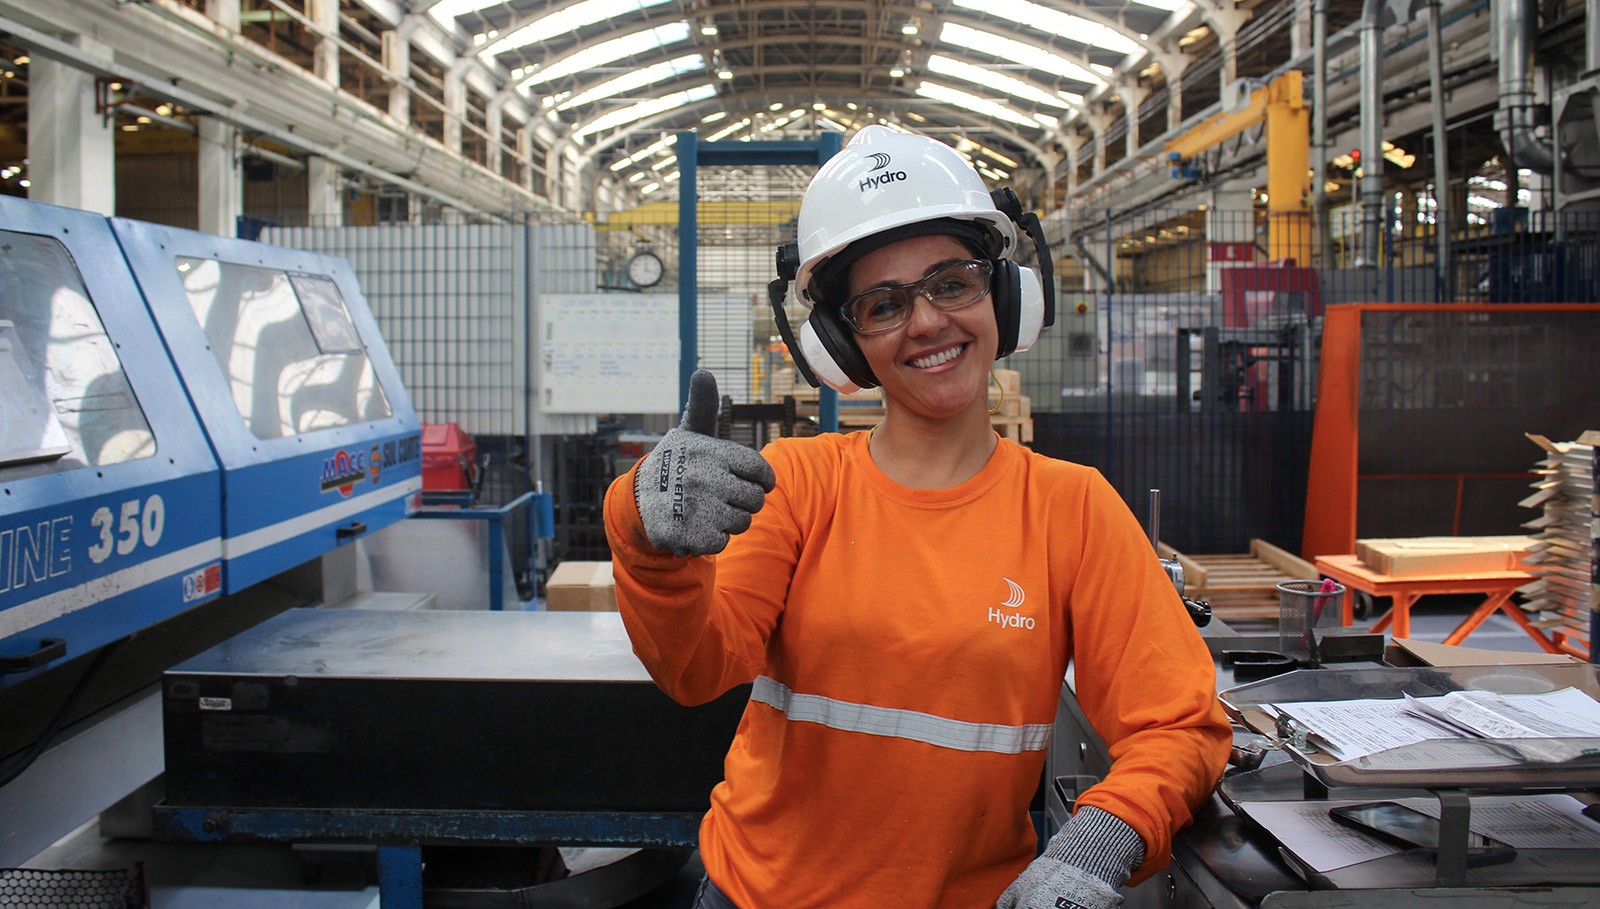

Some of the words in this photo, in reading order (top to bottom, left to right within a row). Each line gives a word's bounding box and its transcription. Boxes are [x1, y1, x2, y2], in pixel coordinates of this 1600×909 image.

[859, 170, 907, 192] Hydro
[323, 451, 365, 481] MACC
[88, 494, 165, 564] 350
[988, 606, 1036, 630] Hydro
